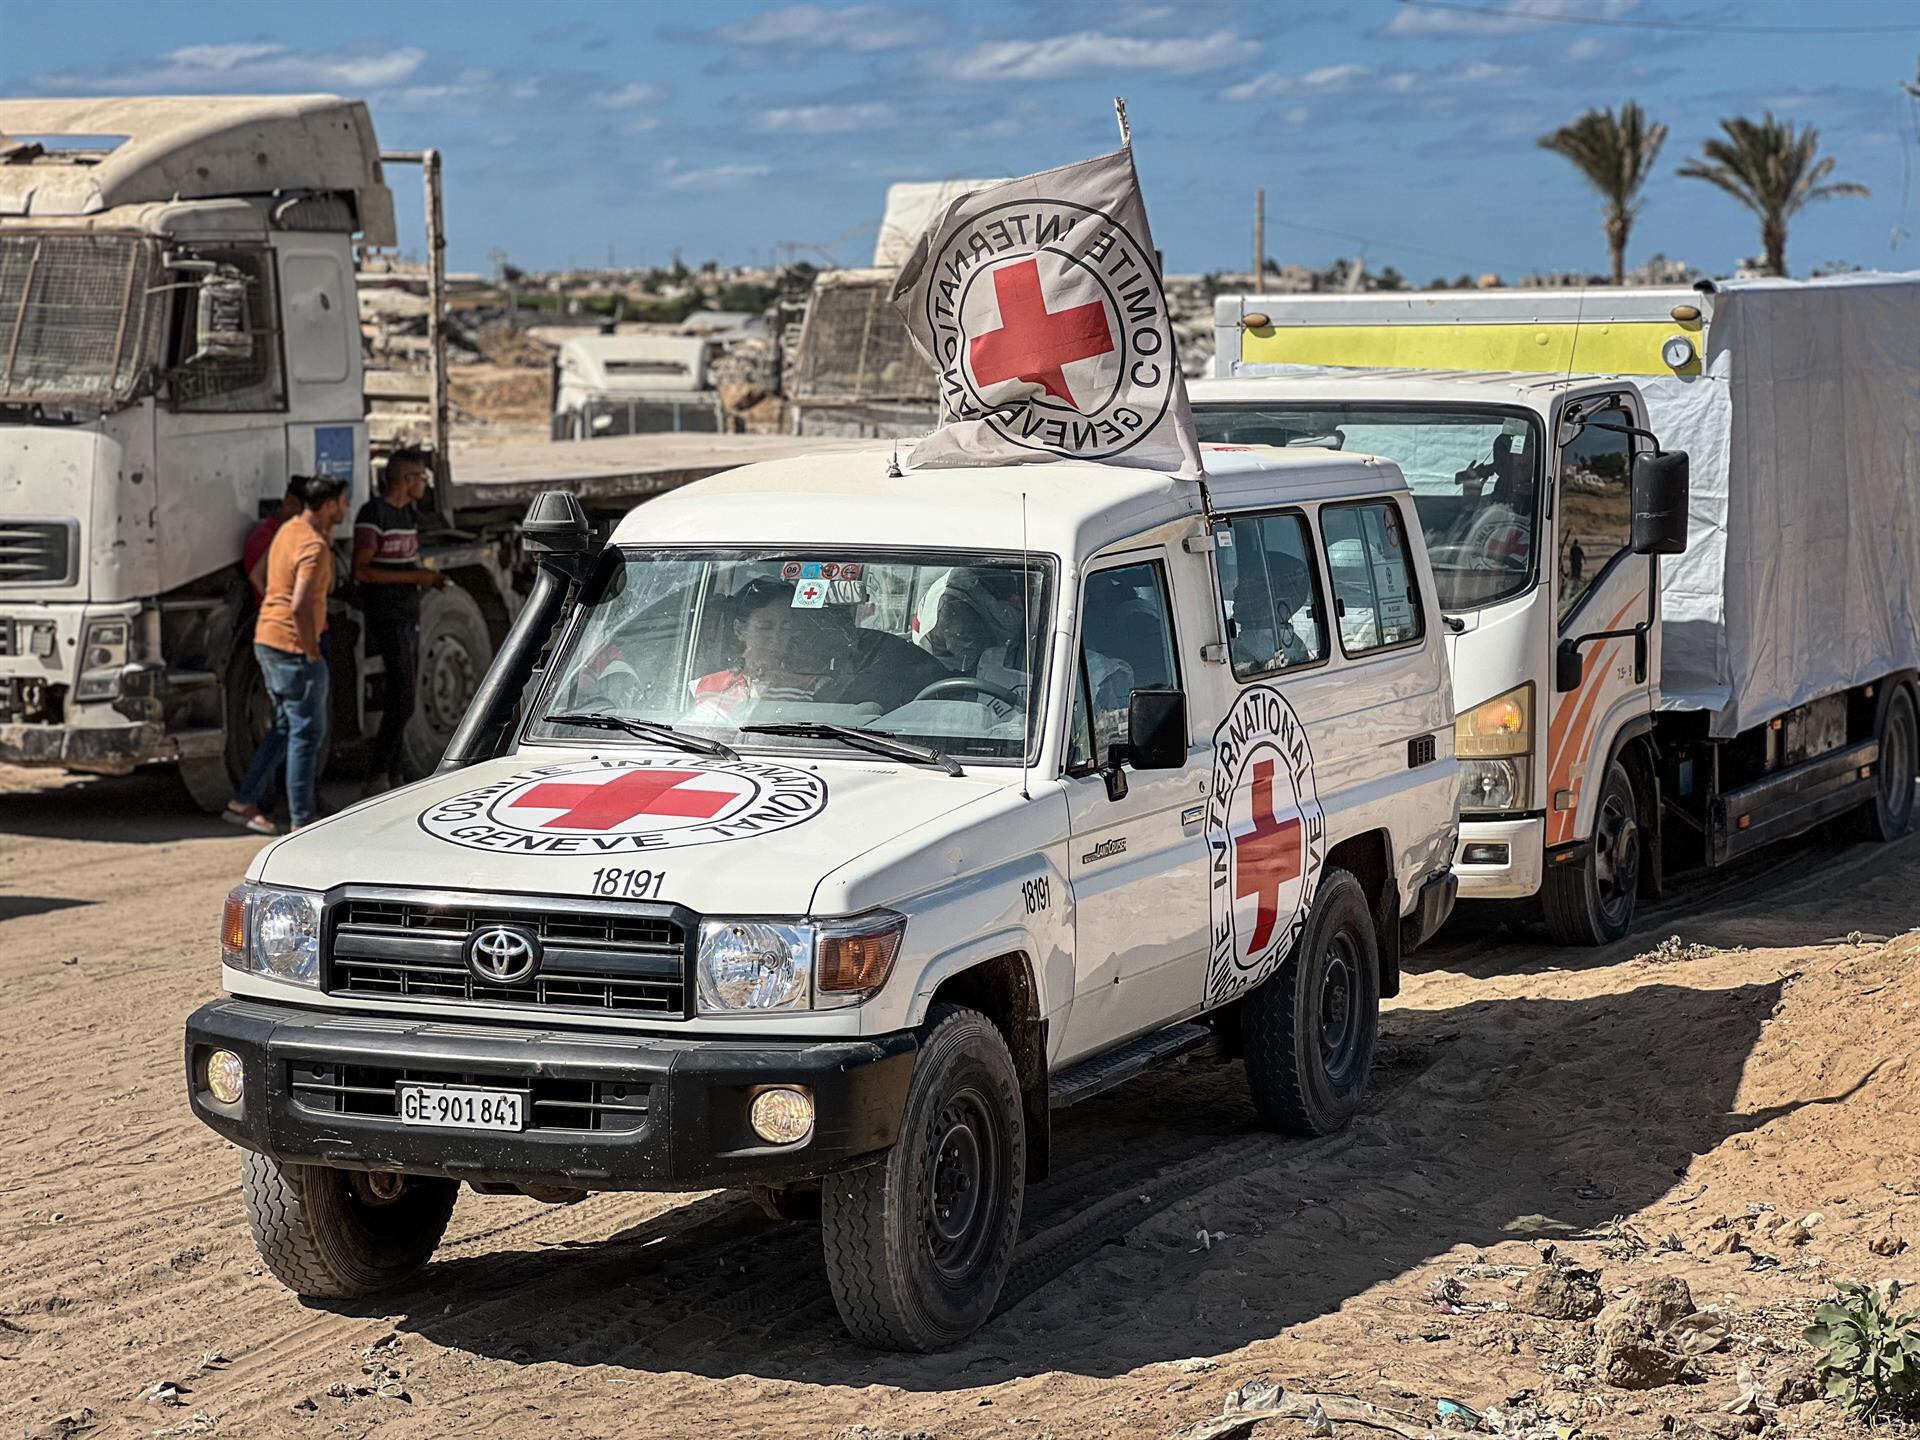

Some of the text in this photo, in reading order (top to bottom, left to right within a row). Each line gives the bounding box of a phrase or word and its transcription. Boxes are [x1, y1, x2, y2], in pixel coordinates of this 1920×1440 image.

[432, 758, 818, 837] COMITE INTERNATIONAL
[1209, 693, 1310, 889] INTERNATIONAL
[450, 825, 672, 851] GENEVE
[592, 867, 666, 898] 18191
[1021, 875, 1051, 914] 18191
